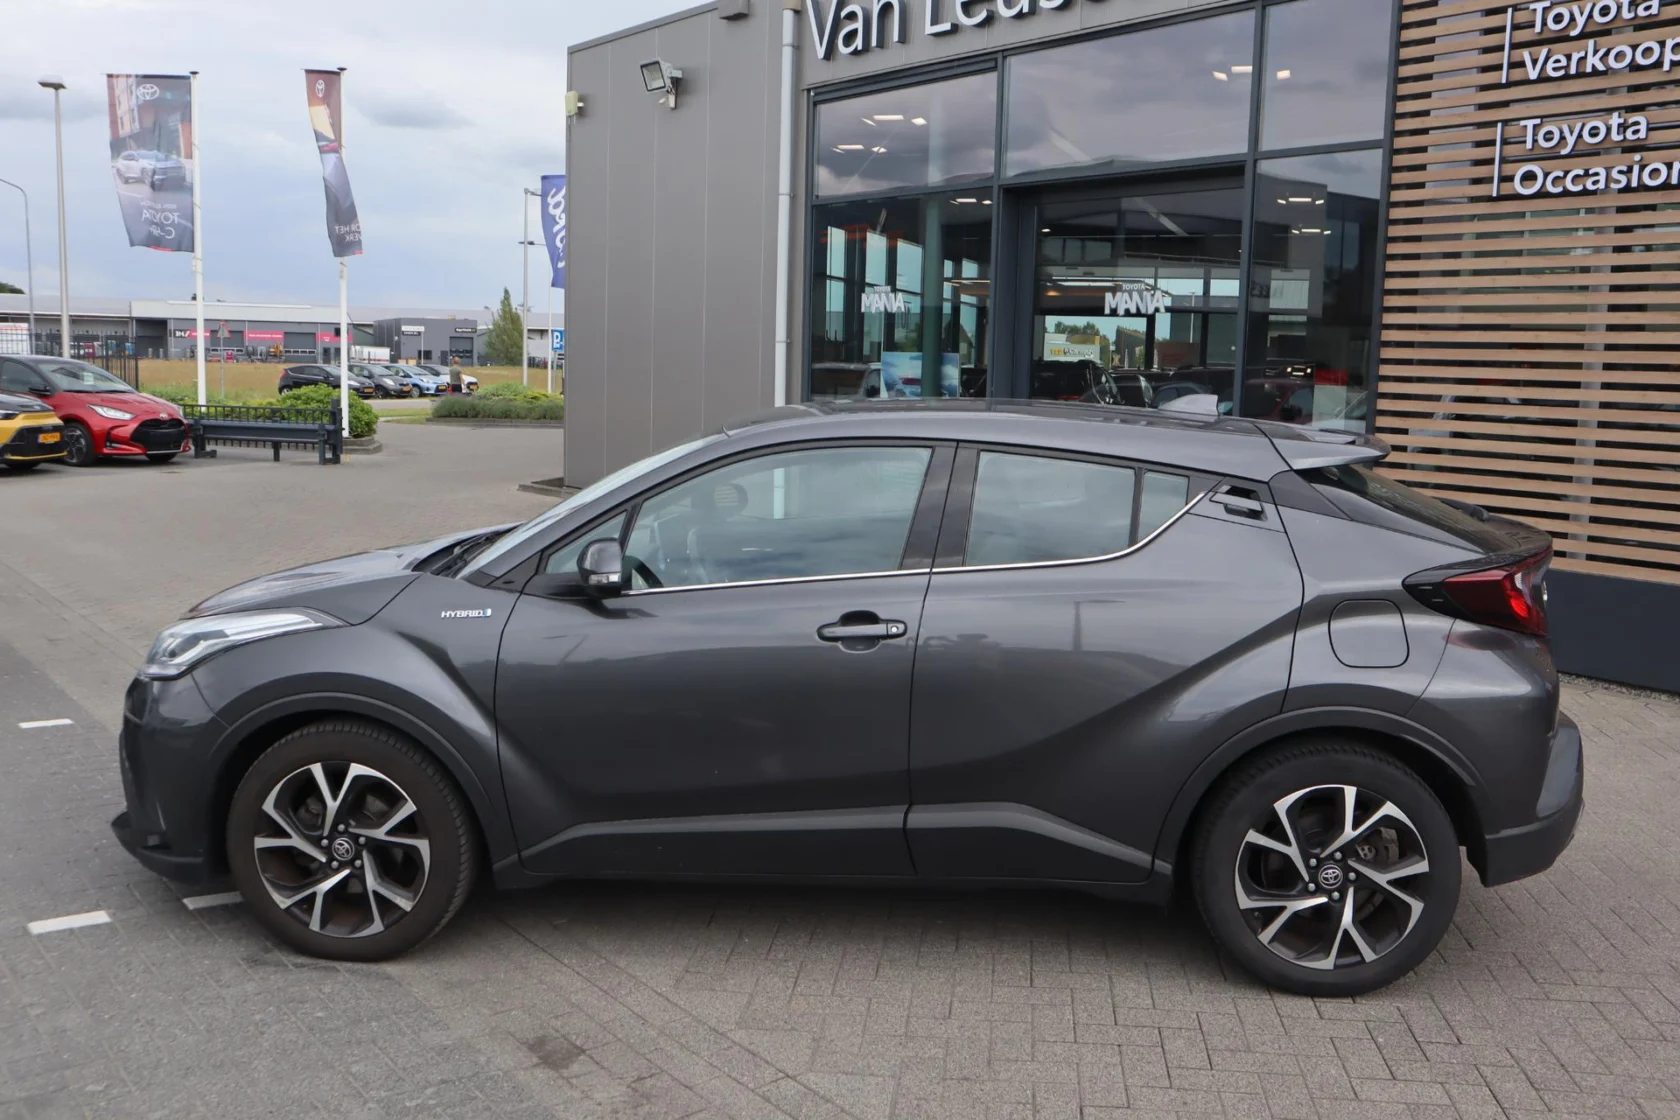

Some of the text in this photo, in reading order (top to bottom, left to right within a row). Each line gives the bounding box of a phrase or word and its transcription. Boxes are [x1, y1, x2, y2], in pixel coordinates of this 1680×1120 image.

[806, 0, 1067, 59] Van Le
[1529, 0, 1661, 37] Toyota
[1522, 36, 1680, 80] Verkoop
[1519, 111, 1649, 155] Toyota
[1122, 283, 1146, 291] TOYOTA
[860, 291, 906, 314] MANIA
[1104, 289, 1166, 317] MANIA
[553, 331, 562, 348] P
[440, 609, 484, 618] HYBRID
